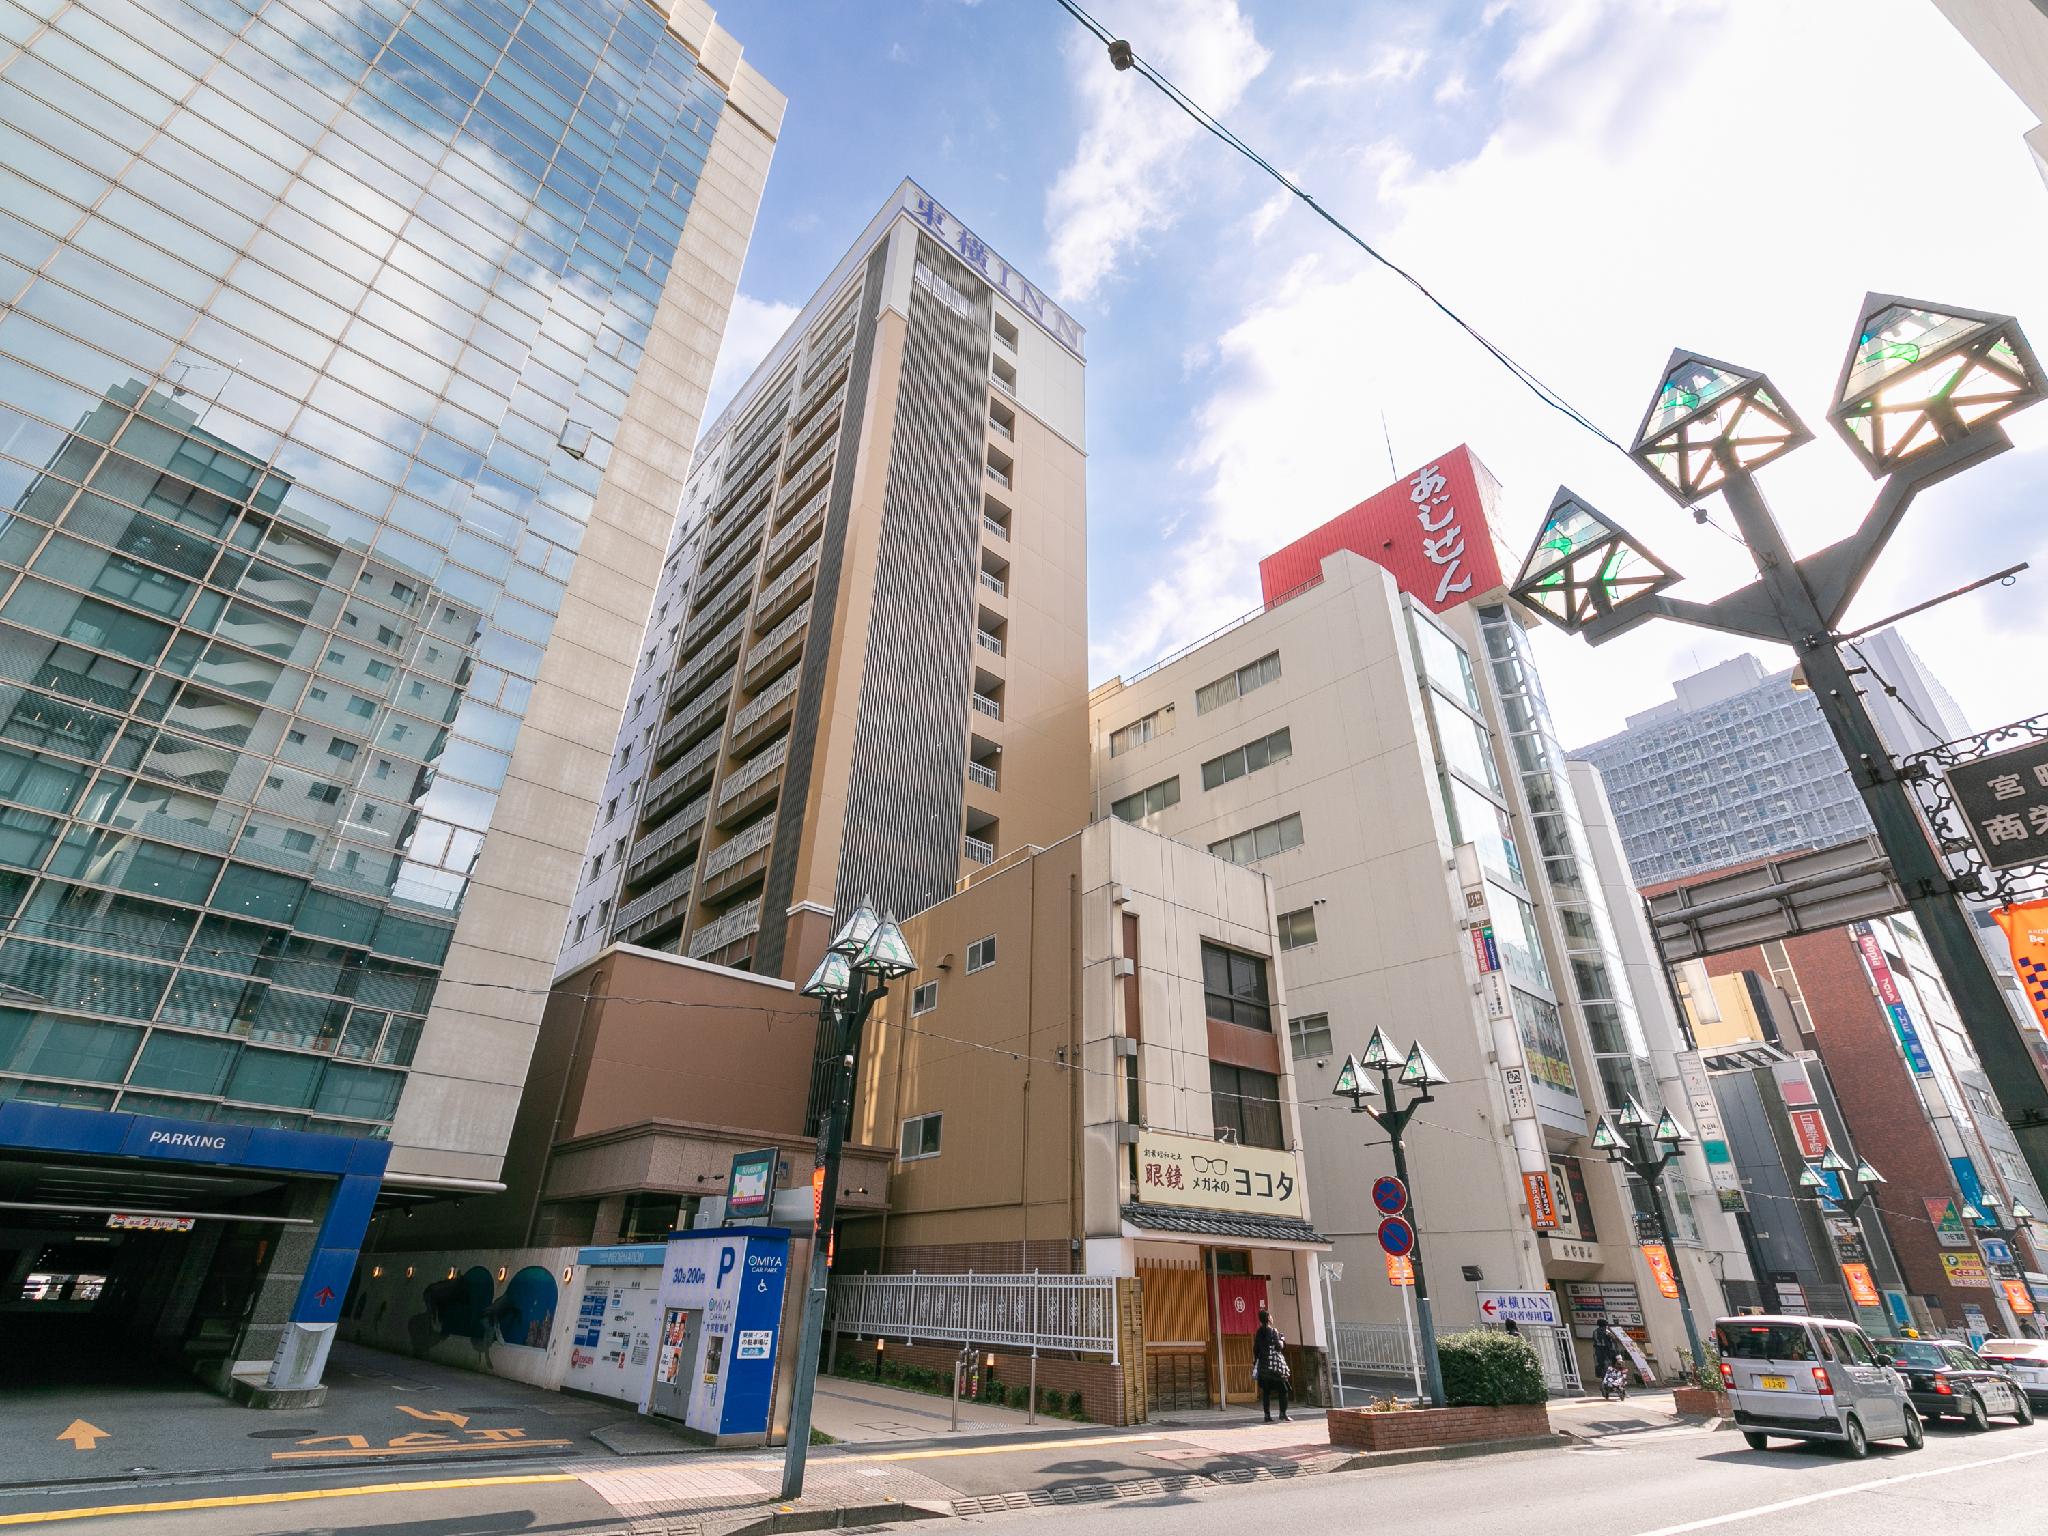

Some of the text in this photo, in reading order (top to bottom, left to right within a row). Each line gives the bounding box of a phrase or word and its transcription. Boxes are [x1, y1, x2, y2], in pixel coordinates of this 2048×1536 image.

[1410, 465, 1472, 602] あじせん
[149, 1131, 226, 1149] PARKING
[1145, 1163, 1185, 1190] 眼鏡
[1192, 1168, 1294, 1201] メガネの ヨコタ
[717, 1246, 736, 1290] P
[748, 1255, 782, 1267] OMIYA
[1496, 1295, 1550, 1310] 東横INN
